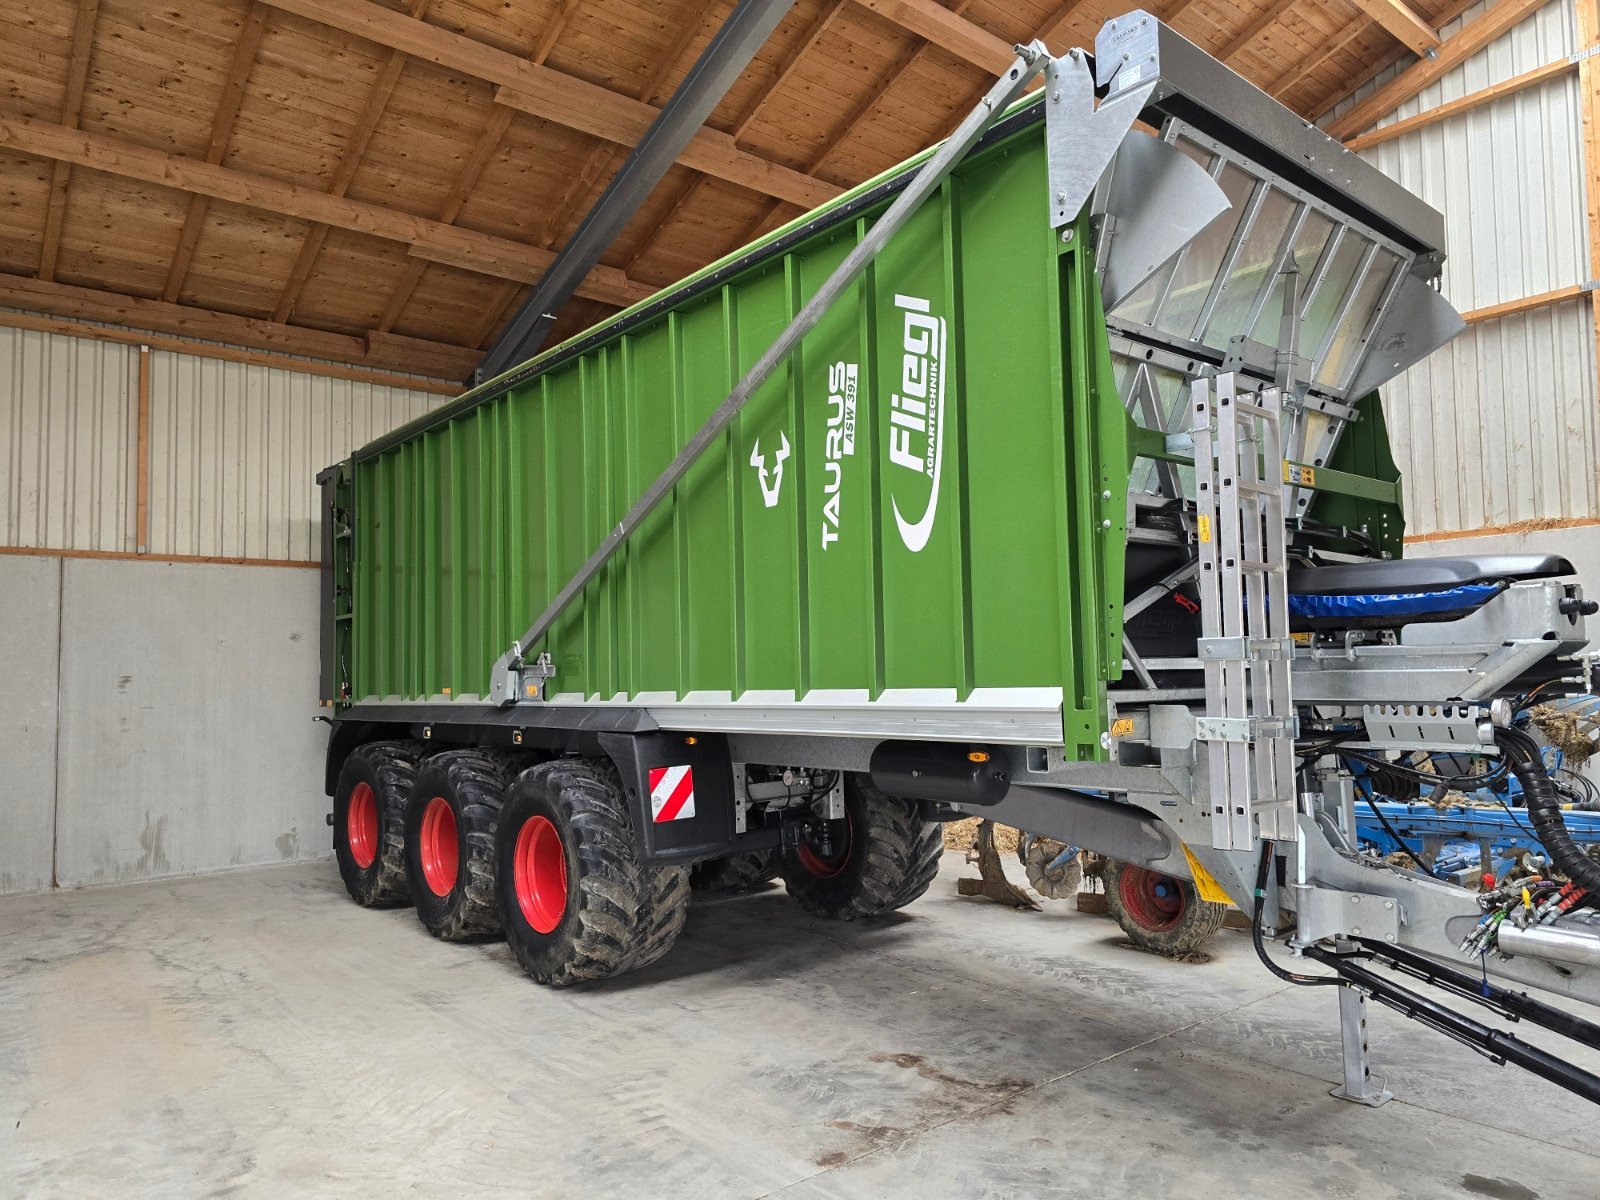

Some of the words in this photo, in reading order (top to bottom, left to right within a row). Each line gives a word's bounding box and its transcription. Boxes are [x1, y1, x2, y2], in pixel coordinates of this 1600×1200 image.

[845, 406, 855, 443] ASW
[846, 375, 856, 403] 391
[889, 294, 938, 473] Fliegl
[926, 361, 938, 478] AGRARTECHNIK
[821, 361, 846, 551] TAURUS
